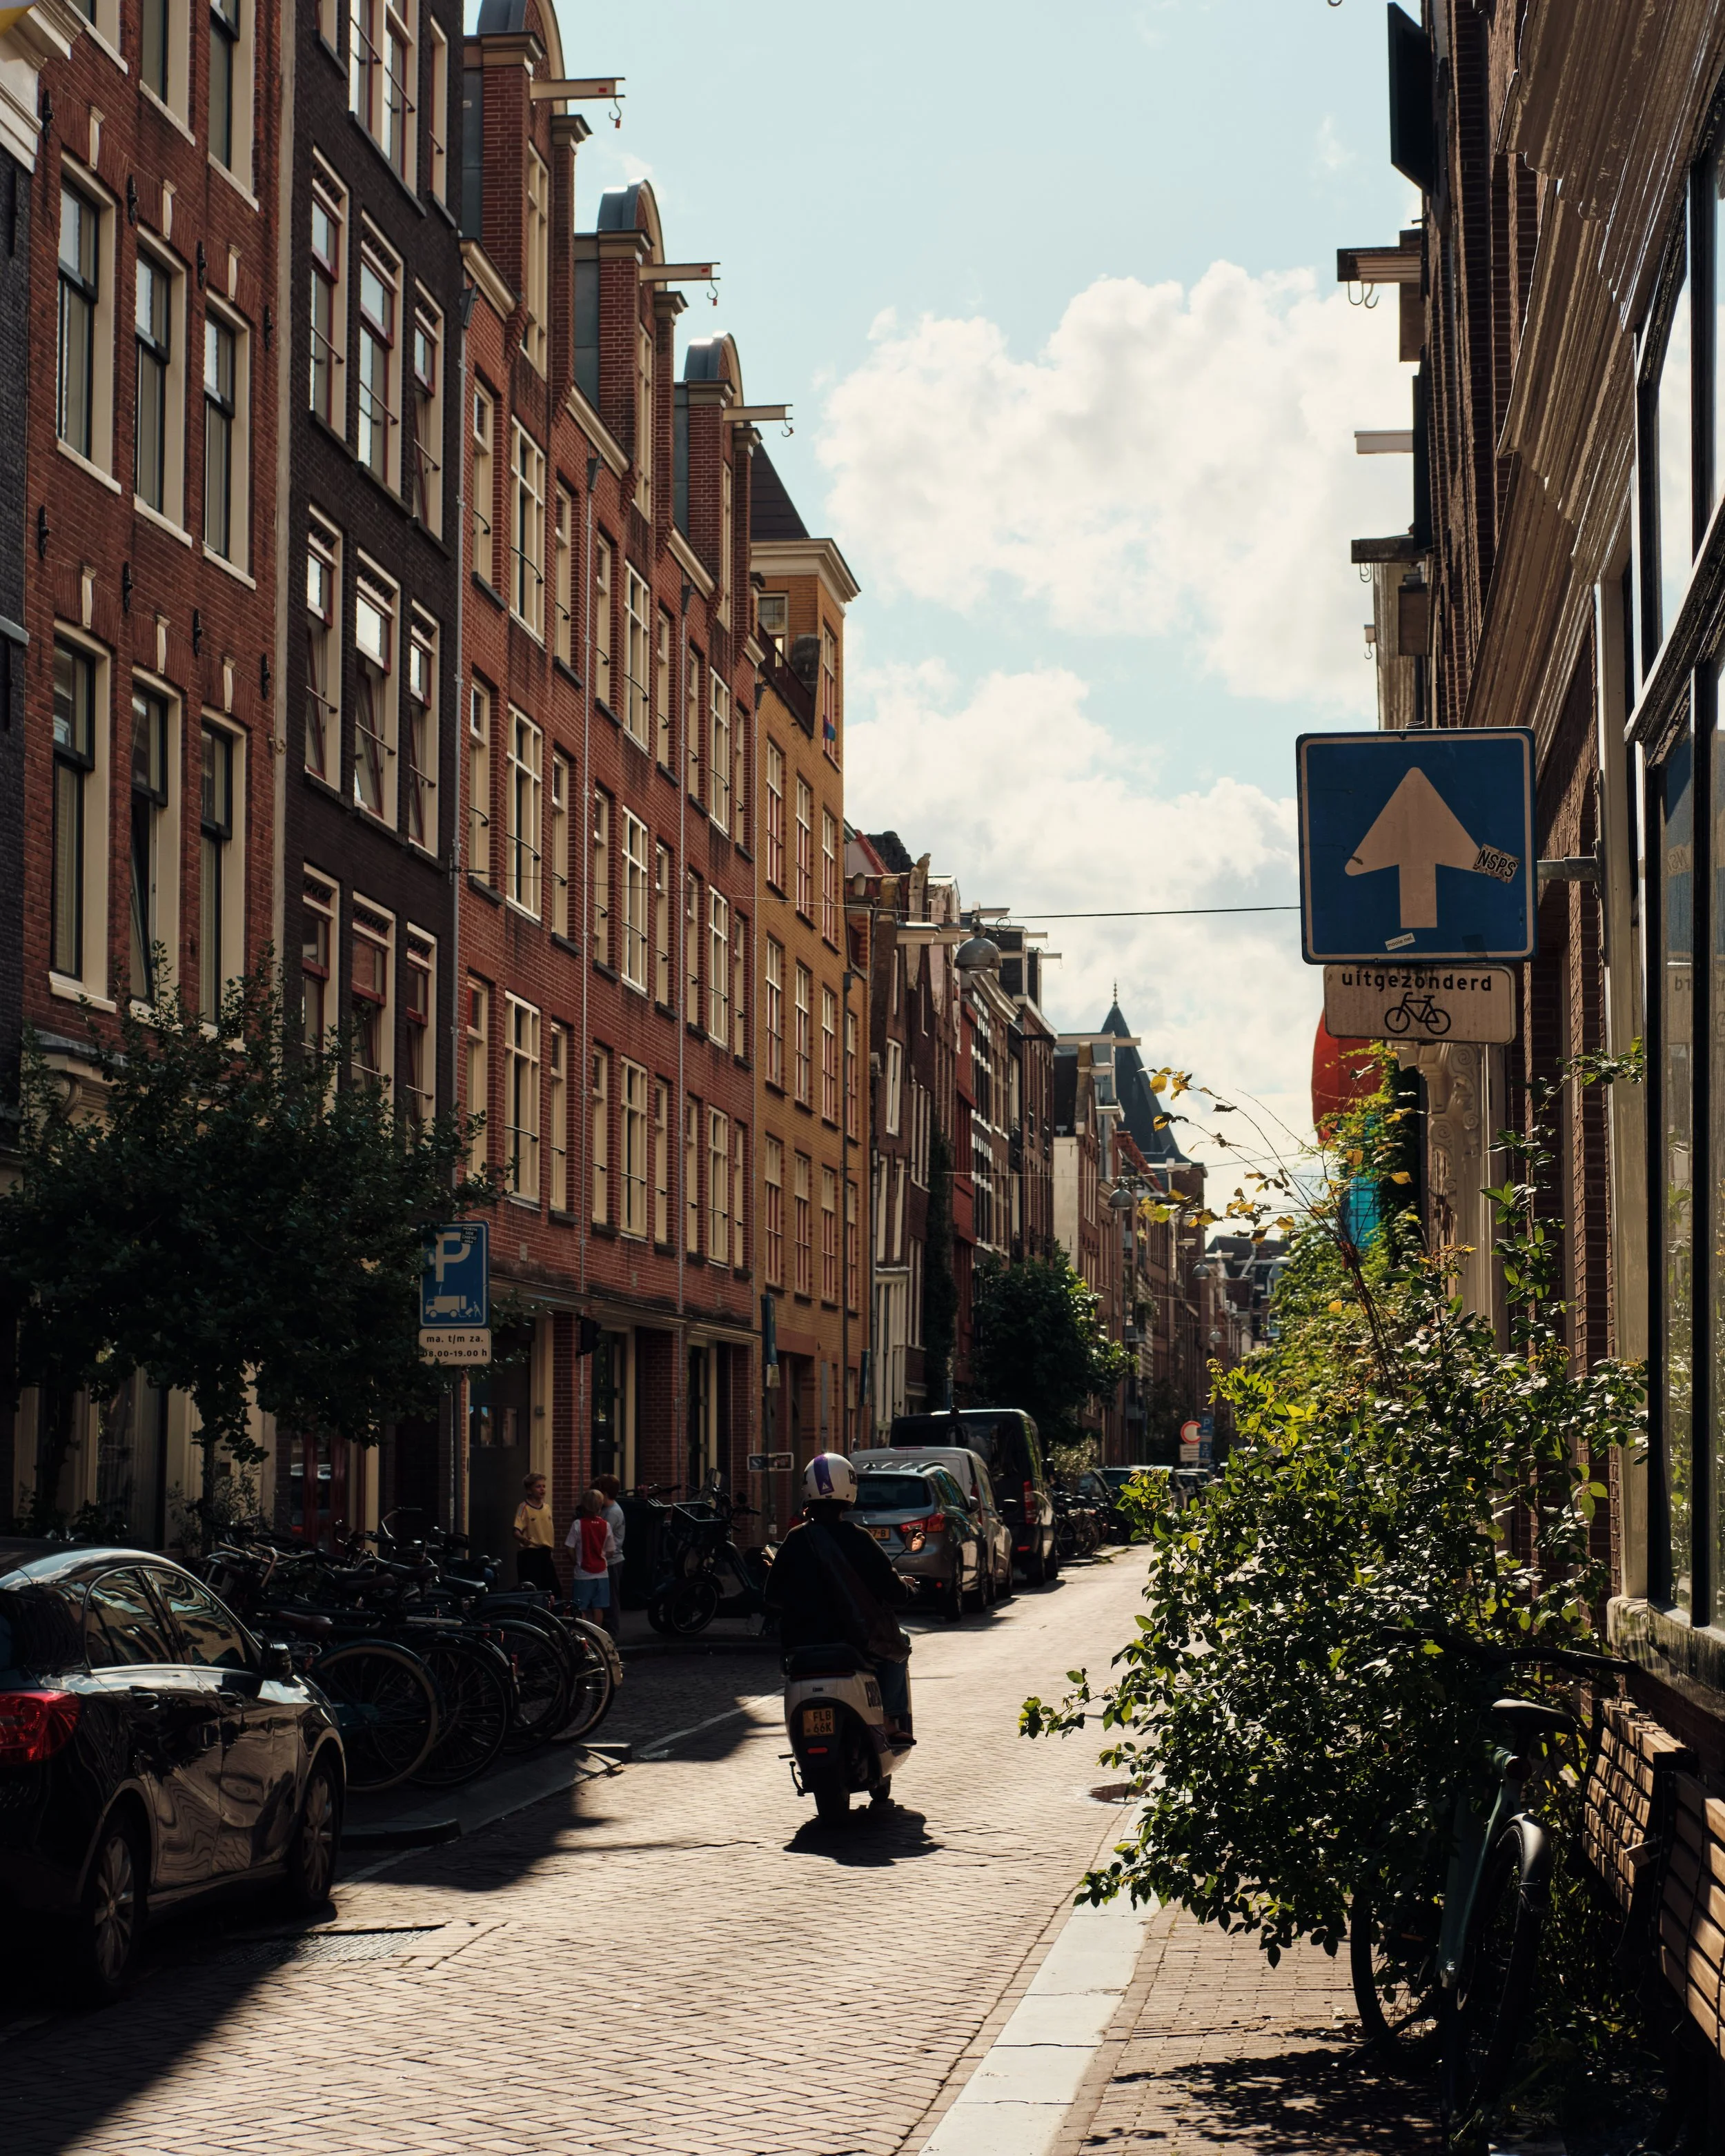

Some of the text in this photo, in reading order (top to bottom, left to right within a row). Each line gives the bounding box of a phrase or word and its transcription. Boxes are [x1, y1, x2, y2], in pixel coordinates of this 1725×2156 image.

[1477, 849, 1517, 878] NSPS
[1342, 971, 1491, 991] uitgezonderd
[435, 1232, 471, 1282] P
[448, 1334, 465, 1345] t/m
[482, 1348, 487, 1356] h
[813, 1710, 831, 1722] FLB
[814, 1722, 832, 1732] 66K
